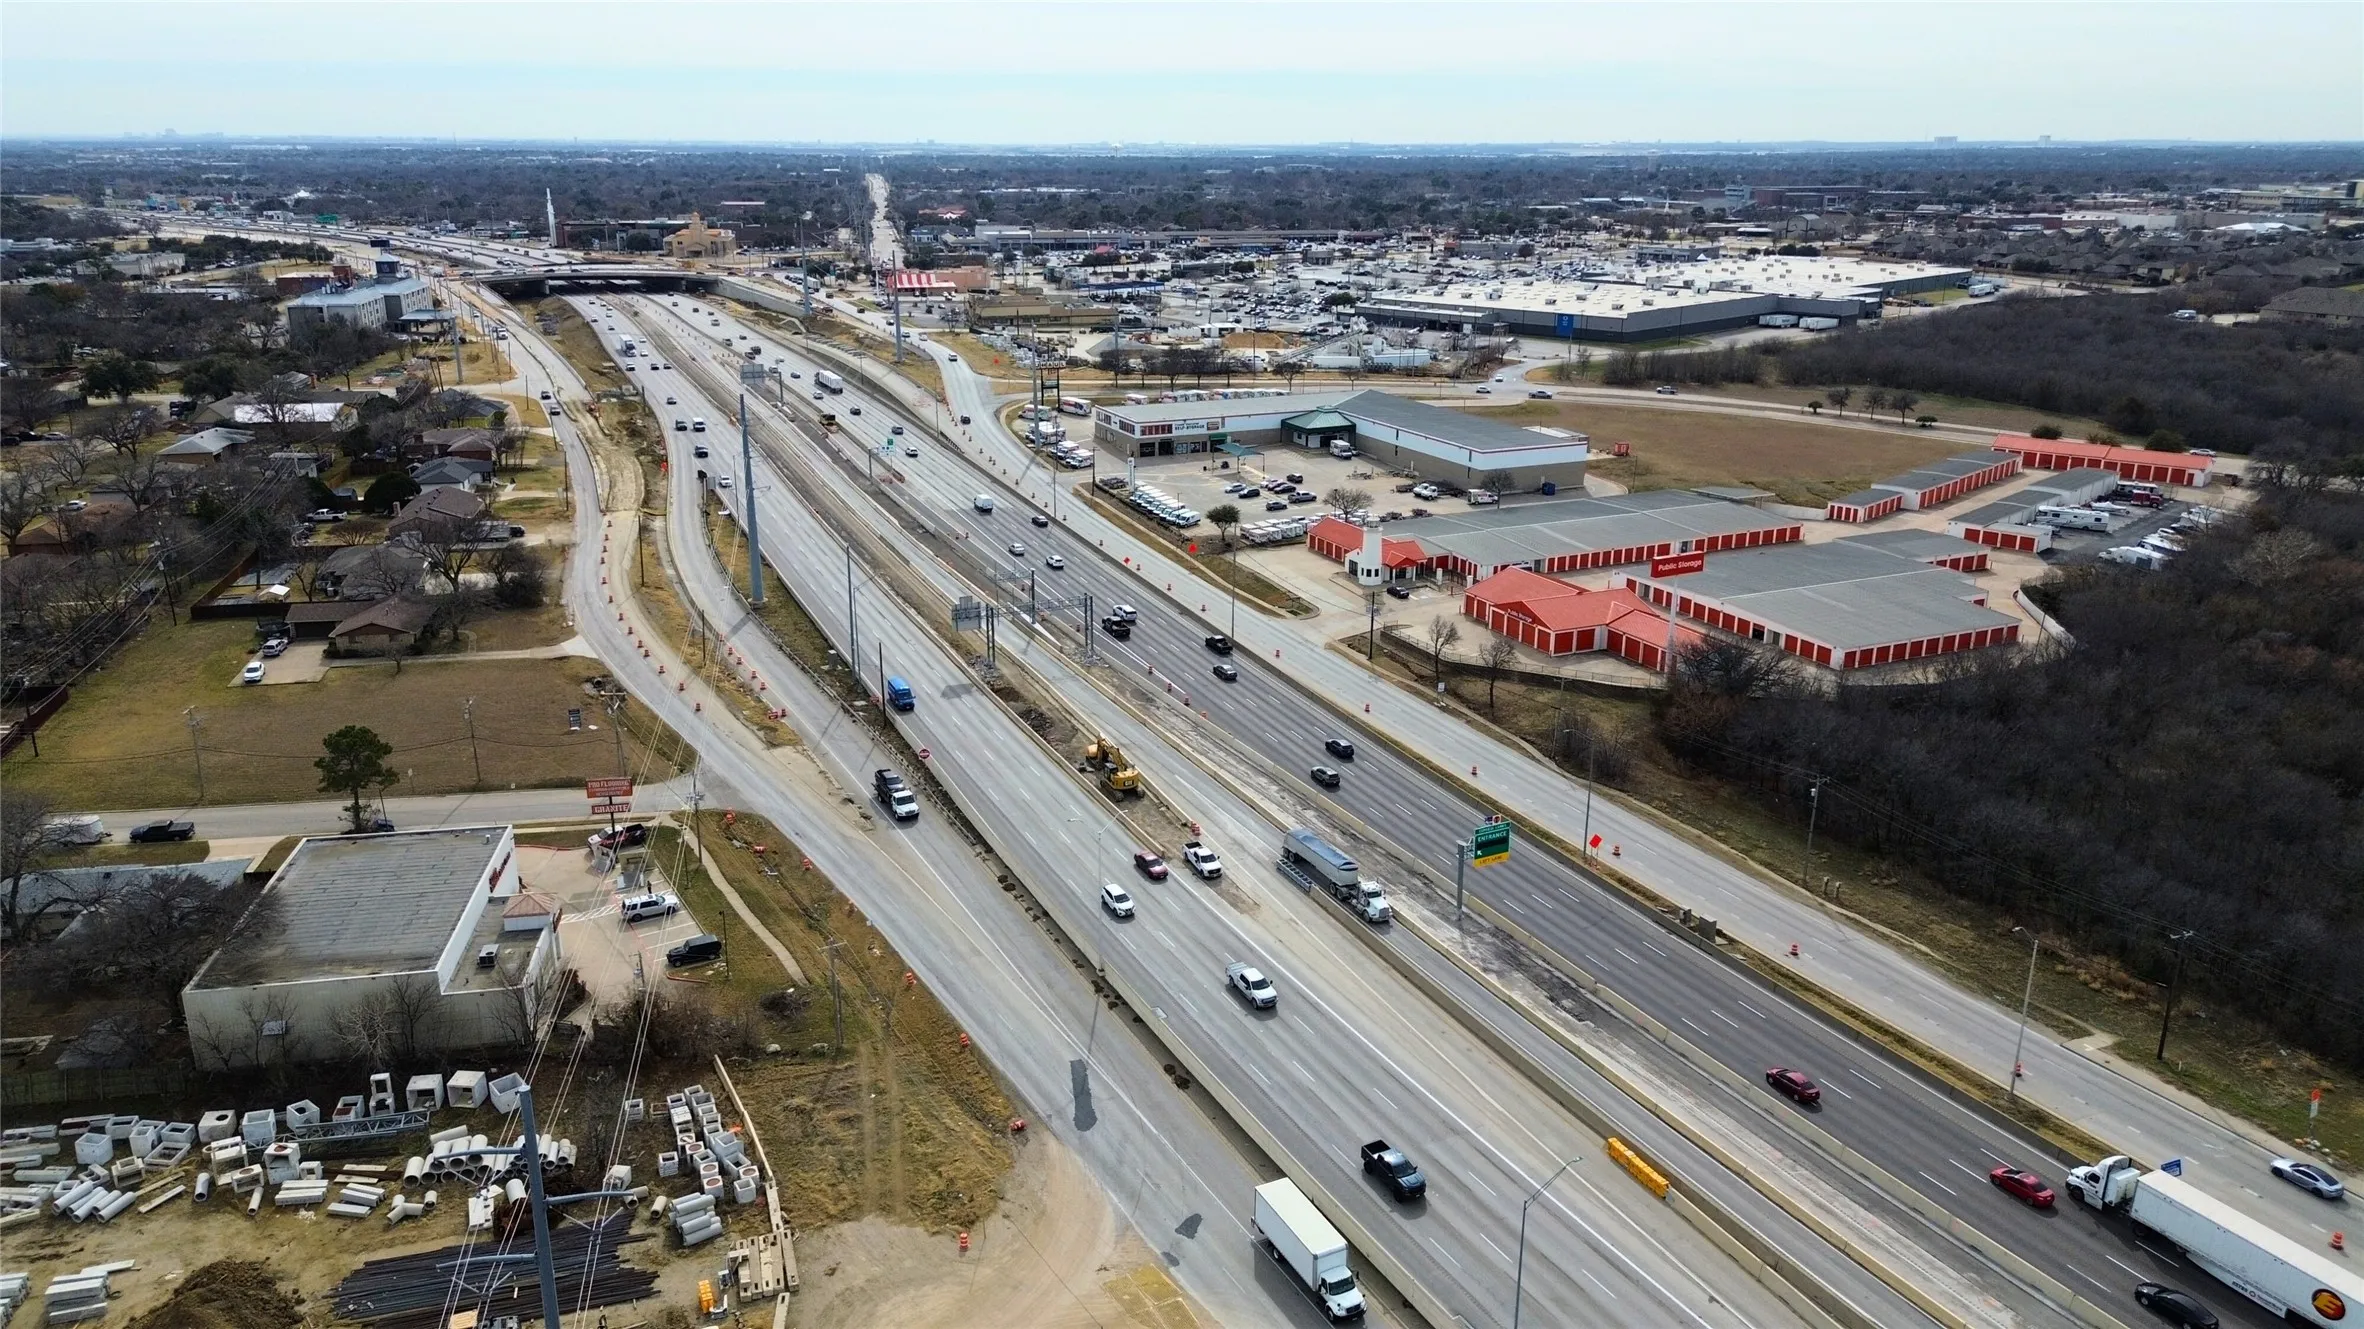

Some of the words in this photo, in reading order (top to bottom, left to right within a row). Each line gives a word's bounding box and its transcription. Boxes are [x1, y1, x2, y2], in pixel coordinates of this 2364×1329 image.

[1658, 563, 1677, 571] Public
[1677, 560, 1702, 568] Storage
[594, 804, 628, 813] GRANITE
[1477, 831, 1507, 842] ENTRANCE
